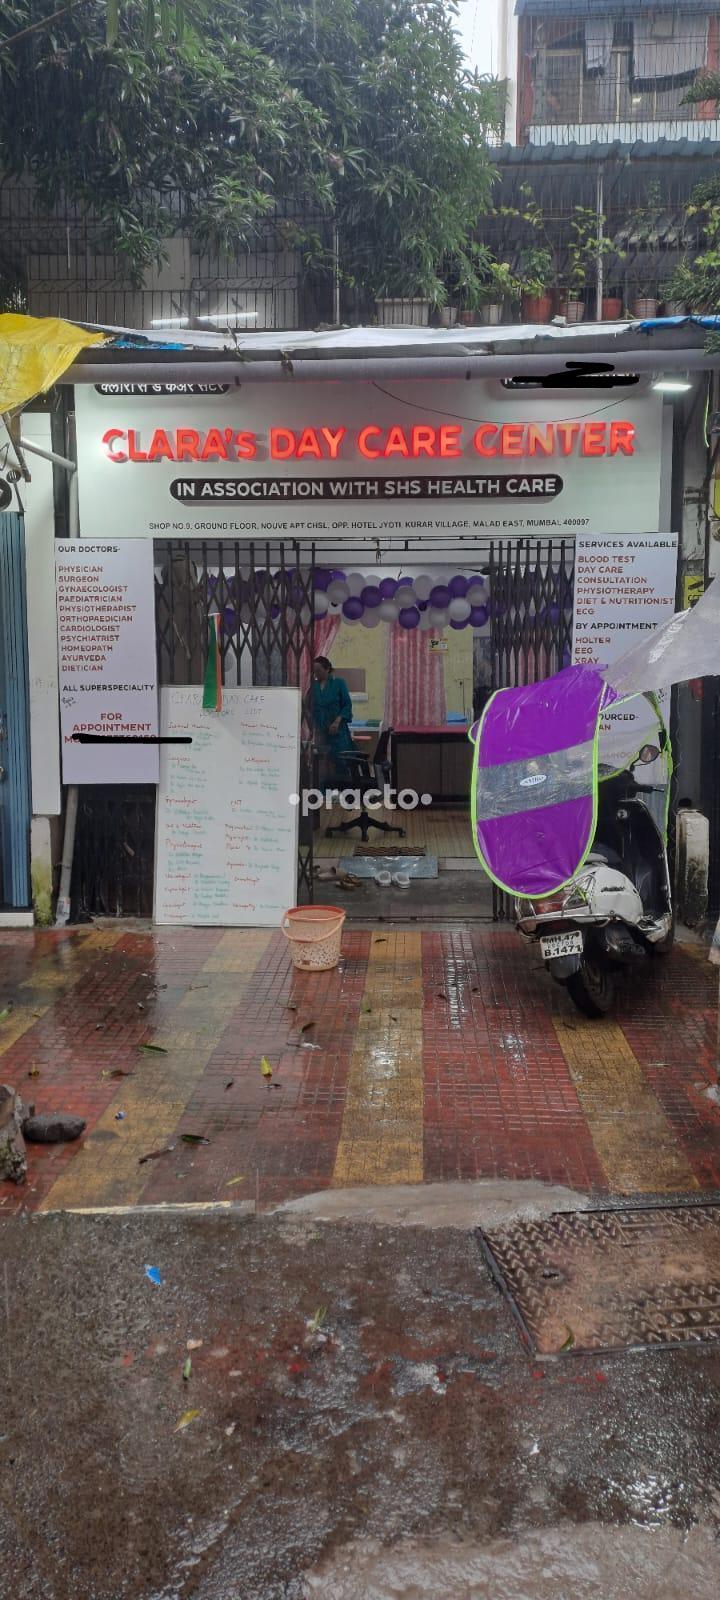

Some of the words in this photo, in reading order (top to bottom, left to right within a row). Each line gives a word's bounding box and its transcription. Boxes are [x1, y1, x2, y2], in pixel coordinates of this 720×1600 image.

[101, 427, 256, 461] CLARA's
[270, 425, 346, 460] DAY
[357, 424, 462, 457] CARE
[473, 421, 636, 457] CENTER
[177, 481, 195, 497] IN
[201, 481, 323, 497] ASSOCIATION
[329, 480, 378, 496] WITH
[384, 480, 421, 495] SHS
[427, 479, 500, 495] HEALTH
[506, 477, 556, 493] CARE
[149, 522, 171, 530] SHOP
[194, 522, 227, 530] GROUND
[261, 522, 287, 530] NOUVE
[306, 522, 330, 530] CHSL,
[351, 521, 377, 529] HOTEL
[436, 520, 471, 529] VILLAGE,
[473, 520, 500, 528] MALAD
[502, 520, 525, 528] EAST,
[563, 518, 590, 526] 400097
[578, 540, 624, 548] SERVICES
[626, 540, 678, 548] AVAILABLE
[58, 545, 76, 553] OUR
[577, 555, 609, 563] BLOOD
[612, 555, 636, 563] TEST
[58, 565, 104, 573] PHYSICIAN
[577, 566, 596, 574] DAY
[598, 566, 624, 574] CARE
[58, 575, 99, 583] SURGEON
[577, 576, 647, 584] CONSULTATION
[58, 585, 128, 593] GYNAECOLOGIST
[576, 587, 655, 595] PHYSIOTHERAPY
[58, 595, 123, 603] PAEDIATRICIAN
[576, 597, 598, 605] DIET
[600, 597, 606, 605] &
[608, 597, 674, 605] NUTRITIONIST
[59, 605, 137, 613] PHYSIOTHERAPIST
[576, 607, 595, 615] ECG
[59, 615, 133, 623] ORTHOPAEDICIAN
[575, 622, 588, 630] BY
[590, 622, 658, 630] APPOINTMENT
[60, 634, 120, 642] PSYCHIATRIST
[575, 636, 611, 644] HOLTER
[61, 644, 113, 652] HOMEOPATH
[574, 647, 593, 655] EEG
[61, 654, 107, 662] AYURVEDA
[62, 664, 104, 672] DIETICIAN
[62, 684, 78, 692] ALL
[79, 684, 155, 692] SUPERSPECIALITY
[100, 712, 123, 721] FOR
[72, 723, 152, 732] APPOINTMENT
